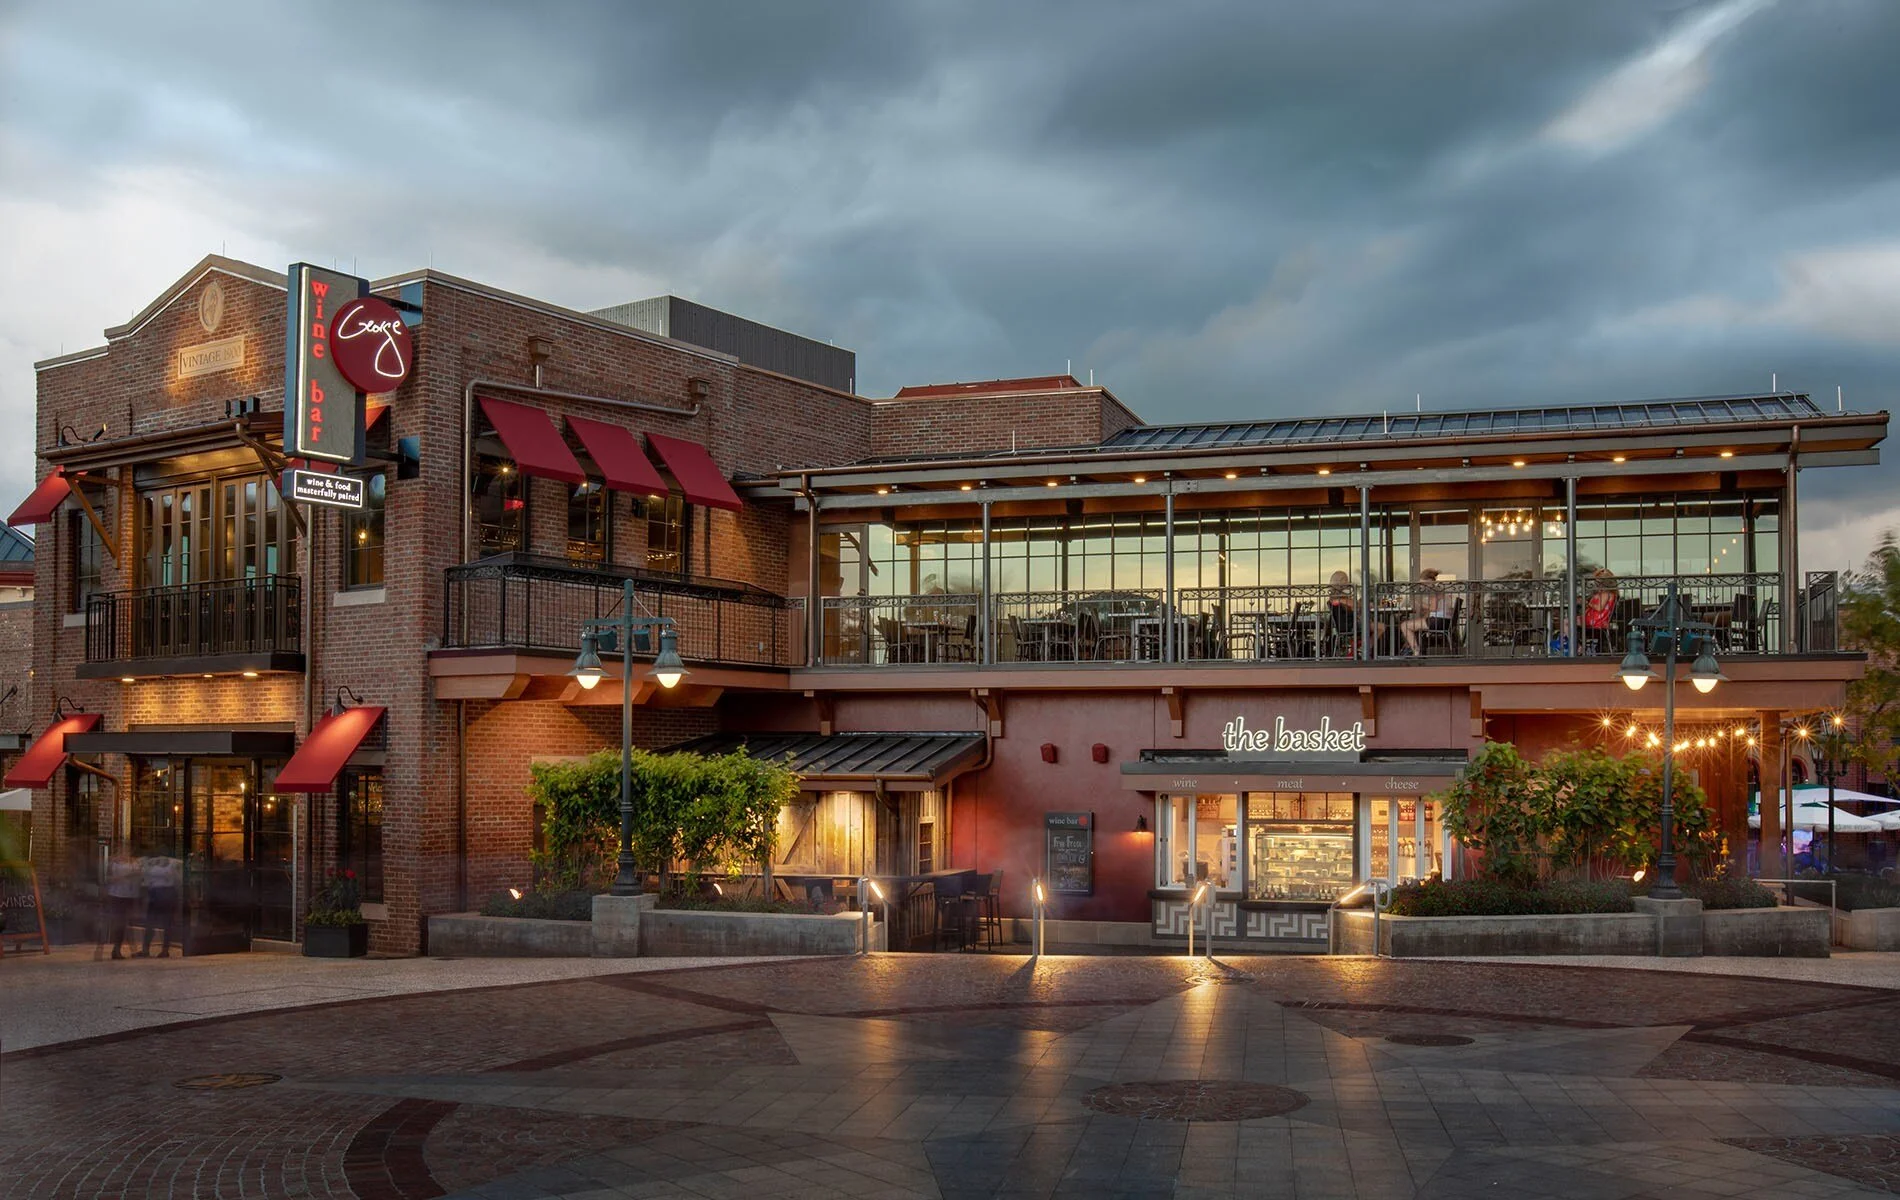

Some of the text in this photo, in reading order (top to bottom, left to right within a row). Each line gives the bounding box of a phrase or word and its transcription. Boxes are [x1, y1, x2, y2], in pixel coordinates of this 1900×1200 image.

[338, 305, 405, 377] George
[183, 351, 220, 368] VINTAGE
[310, 280, 329, 442] wine bar
[307, 478, 351, 491] wine & food
[297, 487, 359, 501] masterfully paired
[1222, 716, 1366, 752] the basket
[1173, 777, 1198, 789] wine
[1277, 778, 1304, 789] meat
[1385, 777, 1419, 789] cheese
[1049, 816, 1078, 825] wine bar
